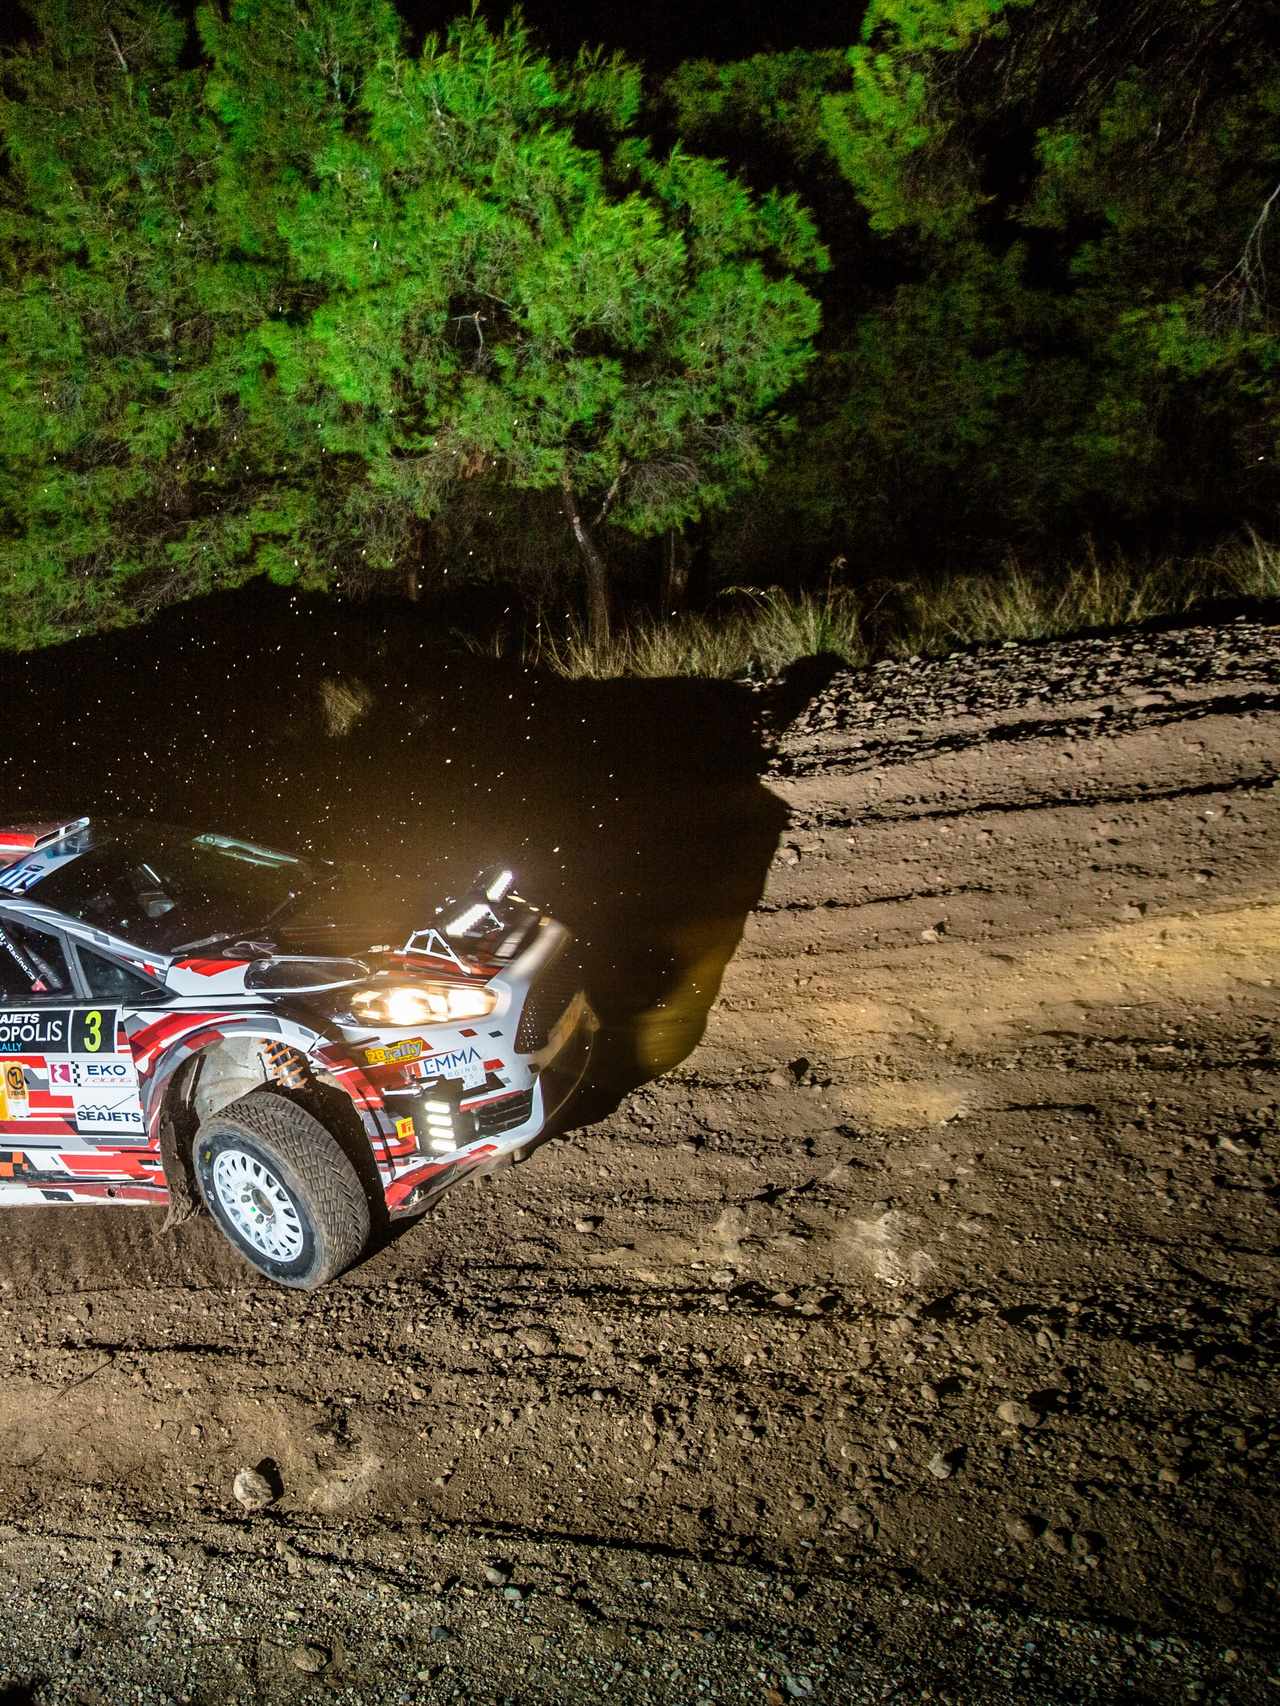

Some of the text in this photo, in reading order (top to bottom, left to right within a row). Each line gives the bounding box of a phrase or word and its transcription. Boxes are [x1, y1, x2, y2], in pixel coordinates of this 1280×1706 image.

[83, 1010, 102, 1052] 3
[365, 1041, 422, 1064] 2Brally
[86, 1064, 127, 1076] EKO
[448, 1065, 478, 1079] RGING
[77, 1110, 141, 1123] SEAJETS
